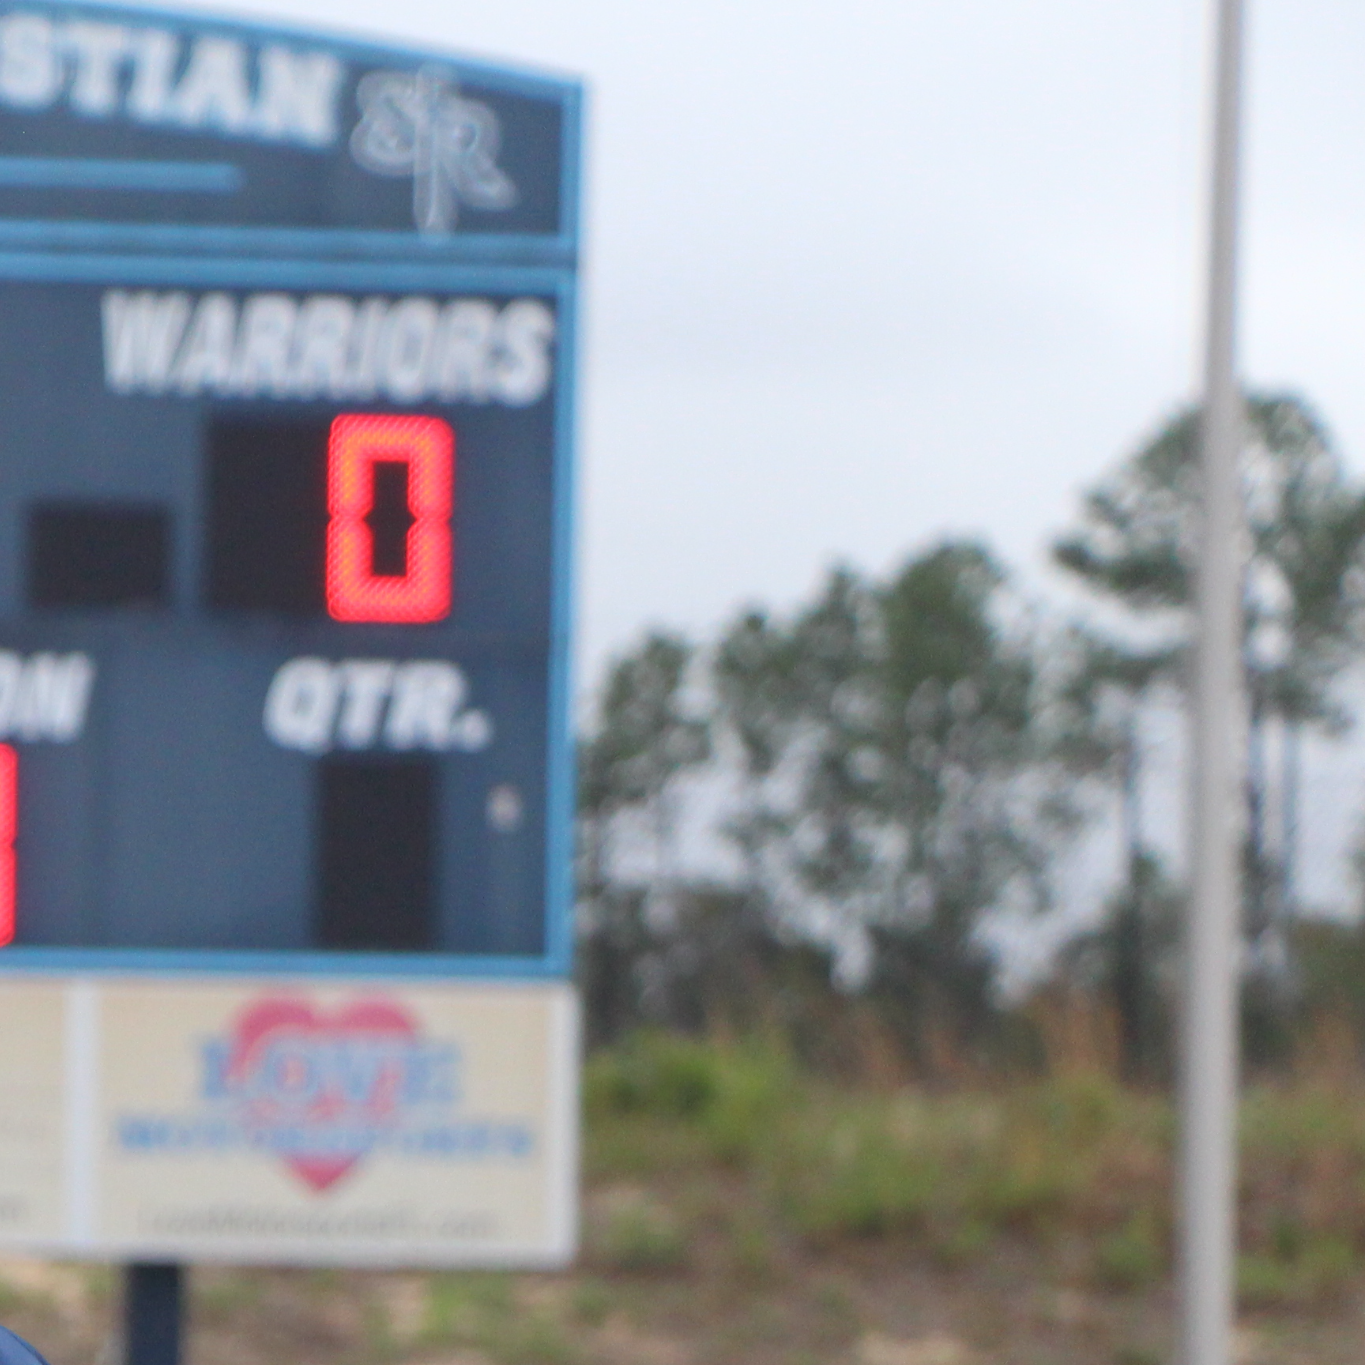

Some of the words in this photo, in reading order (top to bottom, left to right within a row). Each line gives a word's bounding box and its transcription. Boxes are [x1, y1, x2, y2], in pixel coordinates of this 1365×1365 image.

[100, 290, 556, 404] WARRIORS
[324, 413, 455, 624] 0
[263, 656, 491, 753] QTR.
